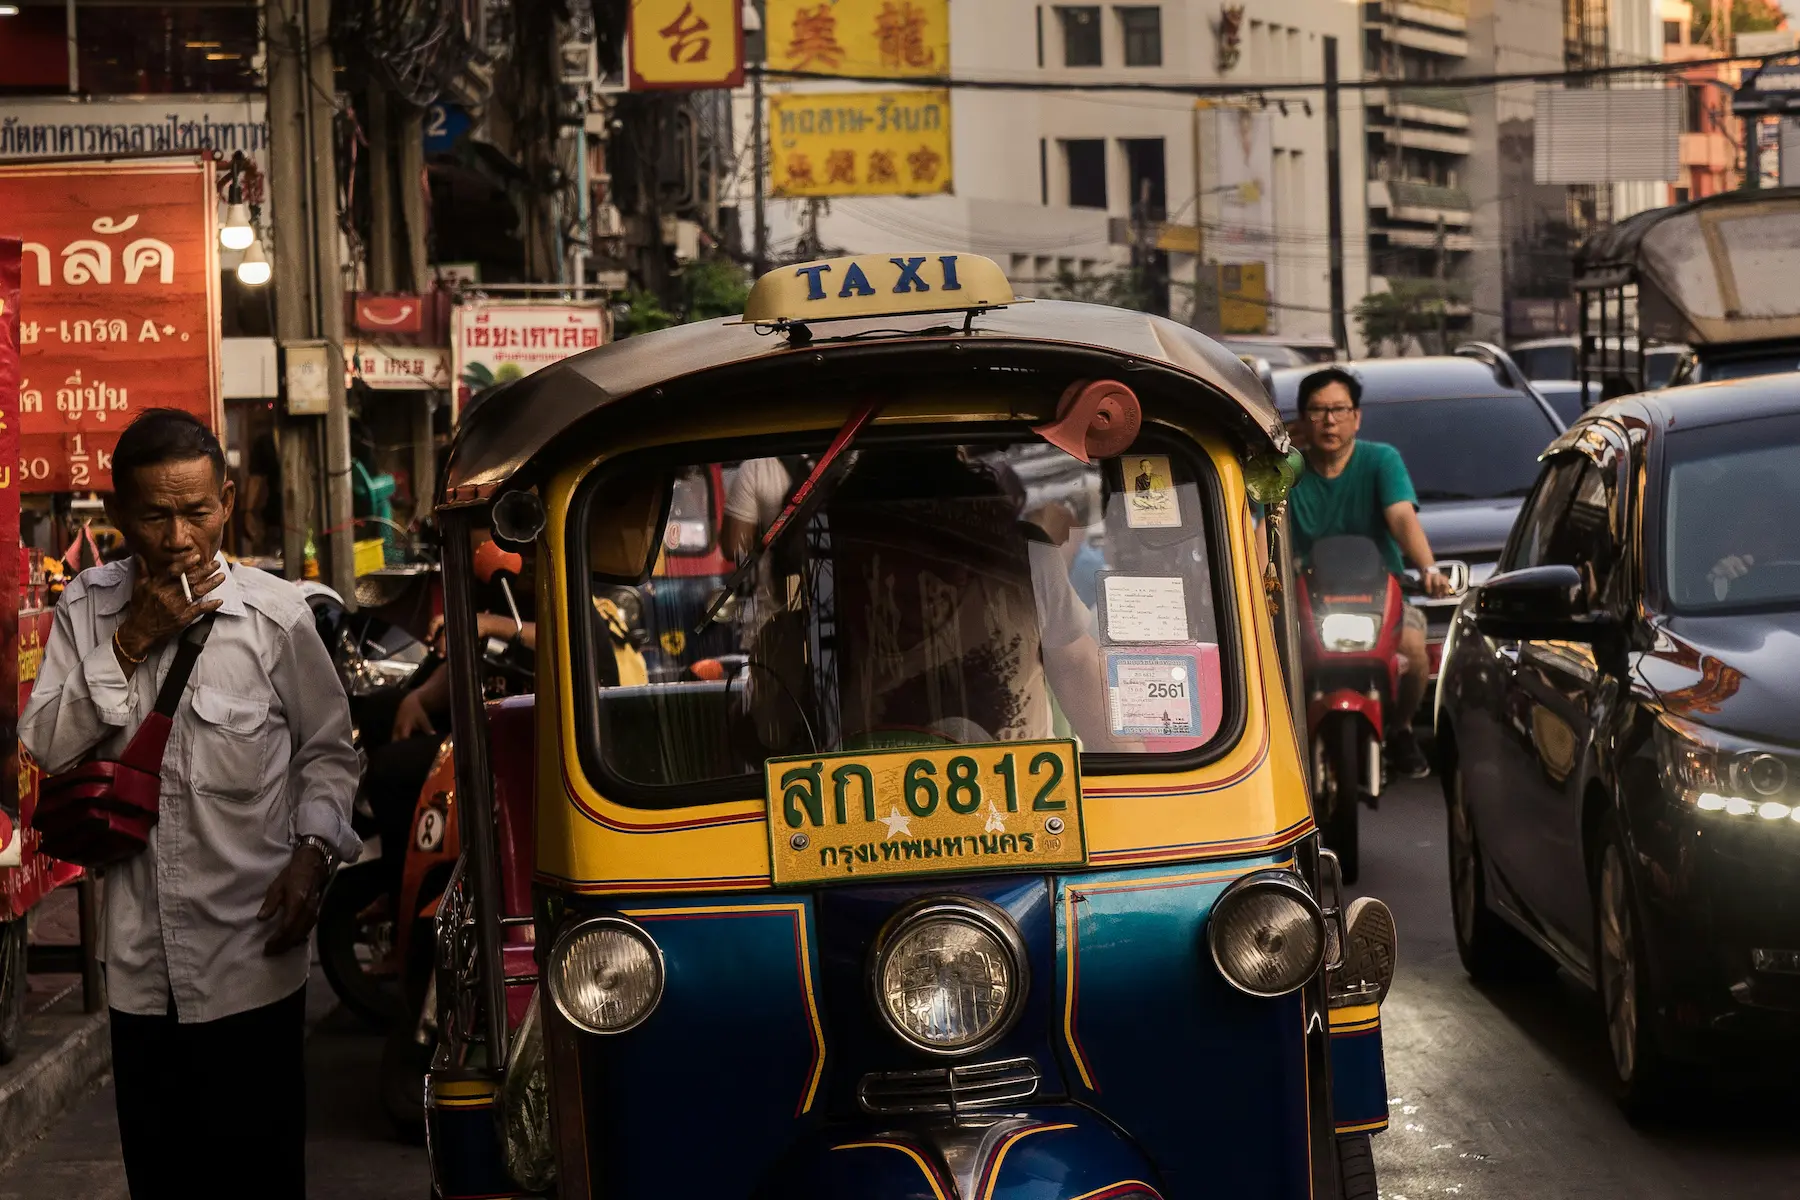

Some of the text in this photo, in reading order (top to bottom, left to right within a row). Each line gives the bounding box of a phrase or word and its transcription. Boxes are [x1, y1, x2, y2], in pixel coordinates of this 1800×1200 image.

[658, 1, 711, 65] 台
[796, 255, 961, 301] TAXI
[56, 369, 128, 422] ญี่ปุ่น
[1147, 682, 1184, 698] 2561
[780, 751, 1068, 829] สก 6812
[820, 832, 1035, 873] กรุงเทพมหานคร
